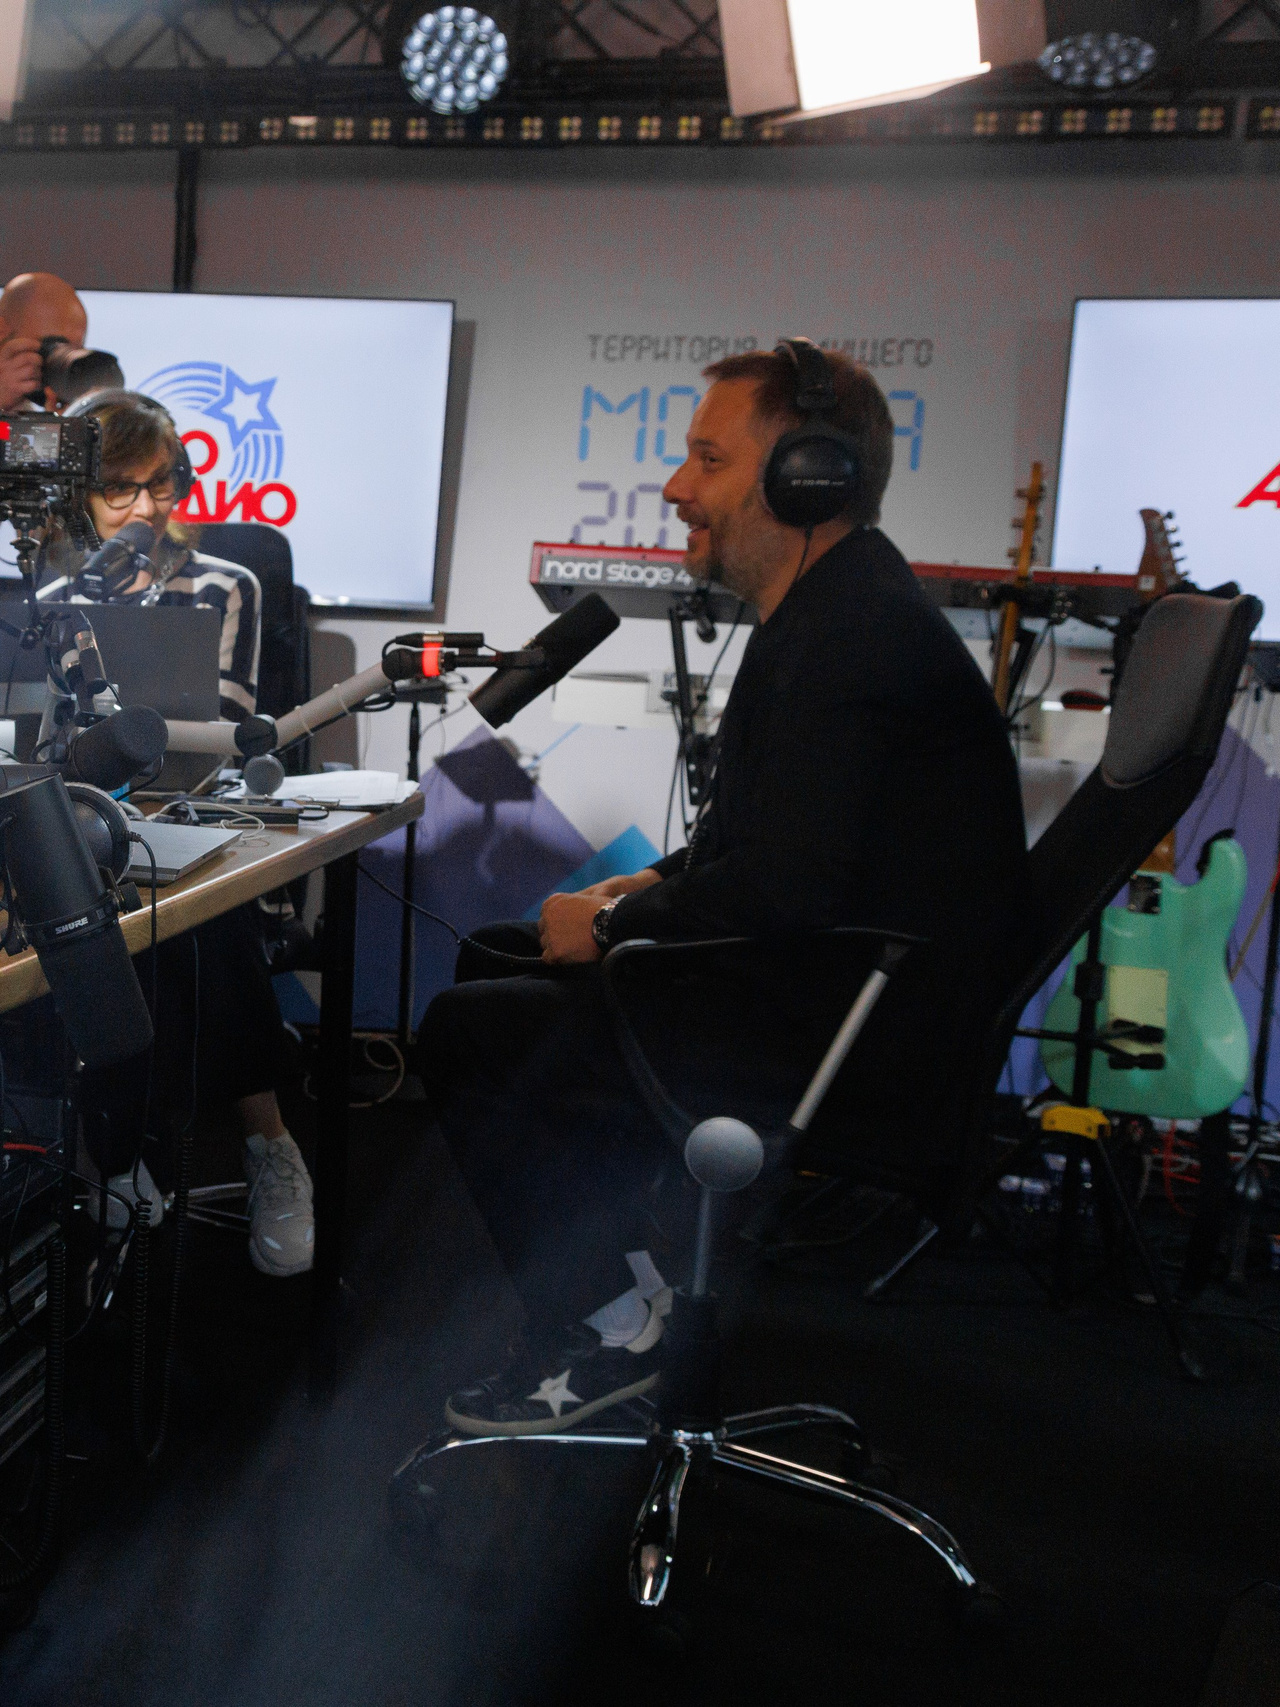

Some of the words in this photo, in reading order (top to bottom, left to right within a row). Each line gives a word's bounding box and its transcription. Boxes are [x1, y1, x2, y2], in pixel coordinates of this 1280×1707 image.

[544, 559, 603, 580] nord
[606, 561, 674, 588] stage
[55, 916, 89, 935] SHURE
